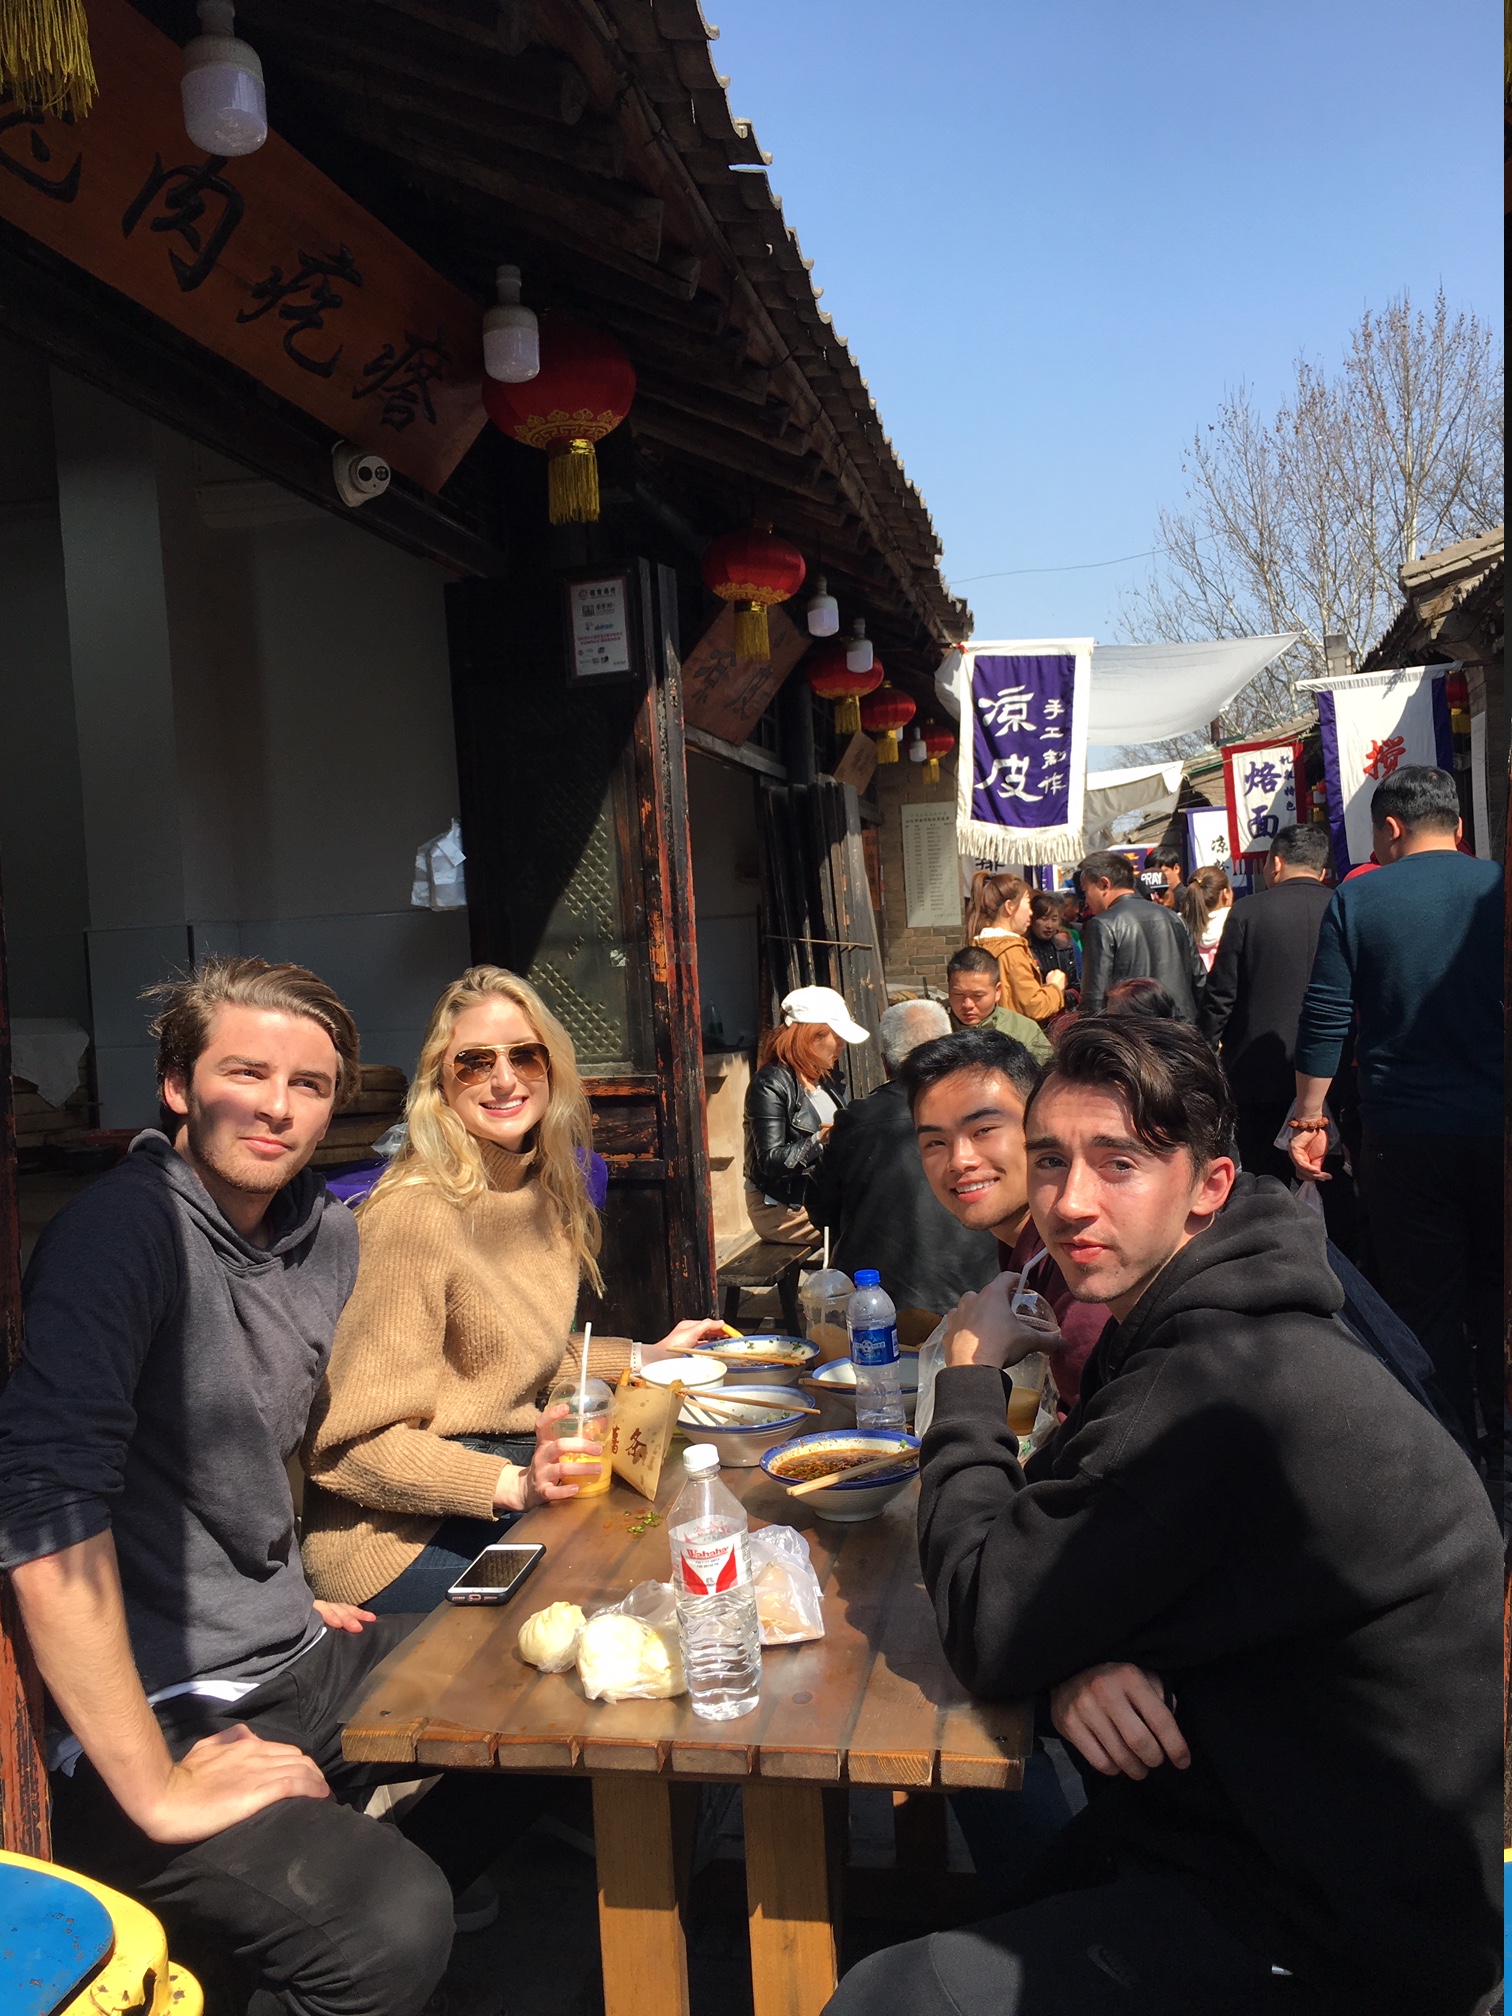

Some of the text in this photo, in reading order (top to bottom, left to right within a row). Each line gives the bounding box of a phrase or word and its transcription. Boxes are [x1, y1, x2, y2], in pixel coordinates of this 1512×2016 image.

[974, 684, 1044, 802] 凉皮
[1038, 699, 1067, 796] 手工制作
[1244, 761, 1282, 839] 烙面
[686, 1547, 729, 1559] Wahaha
